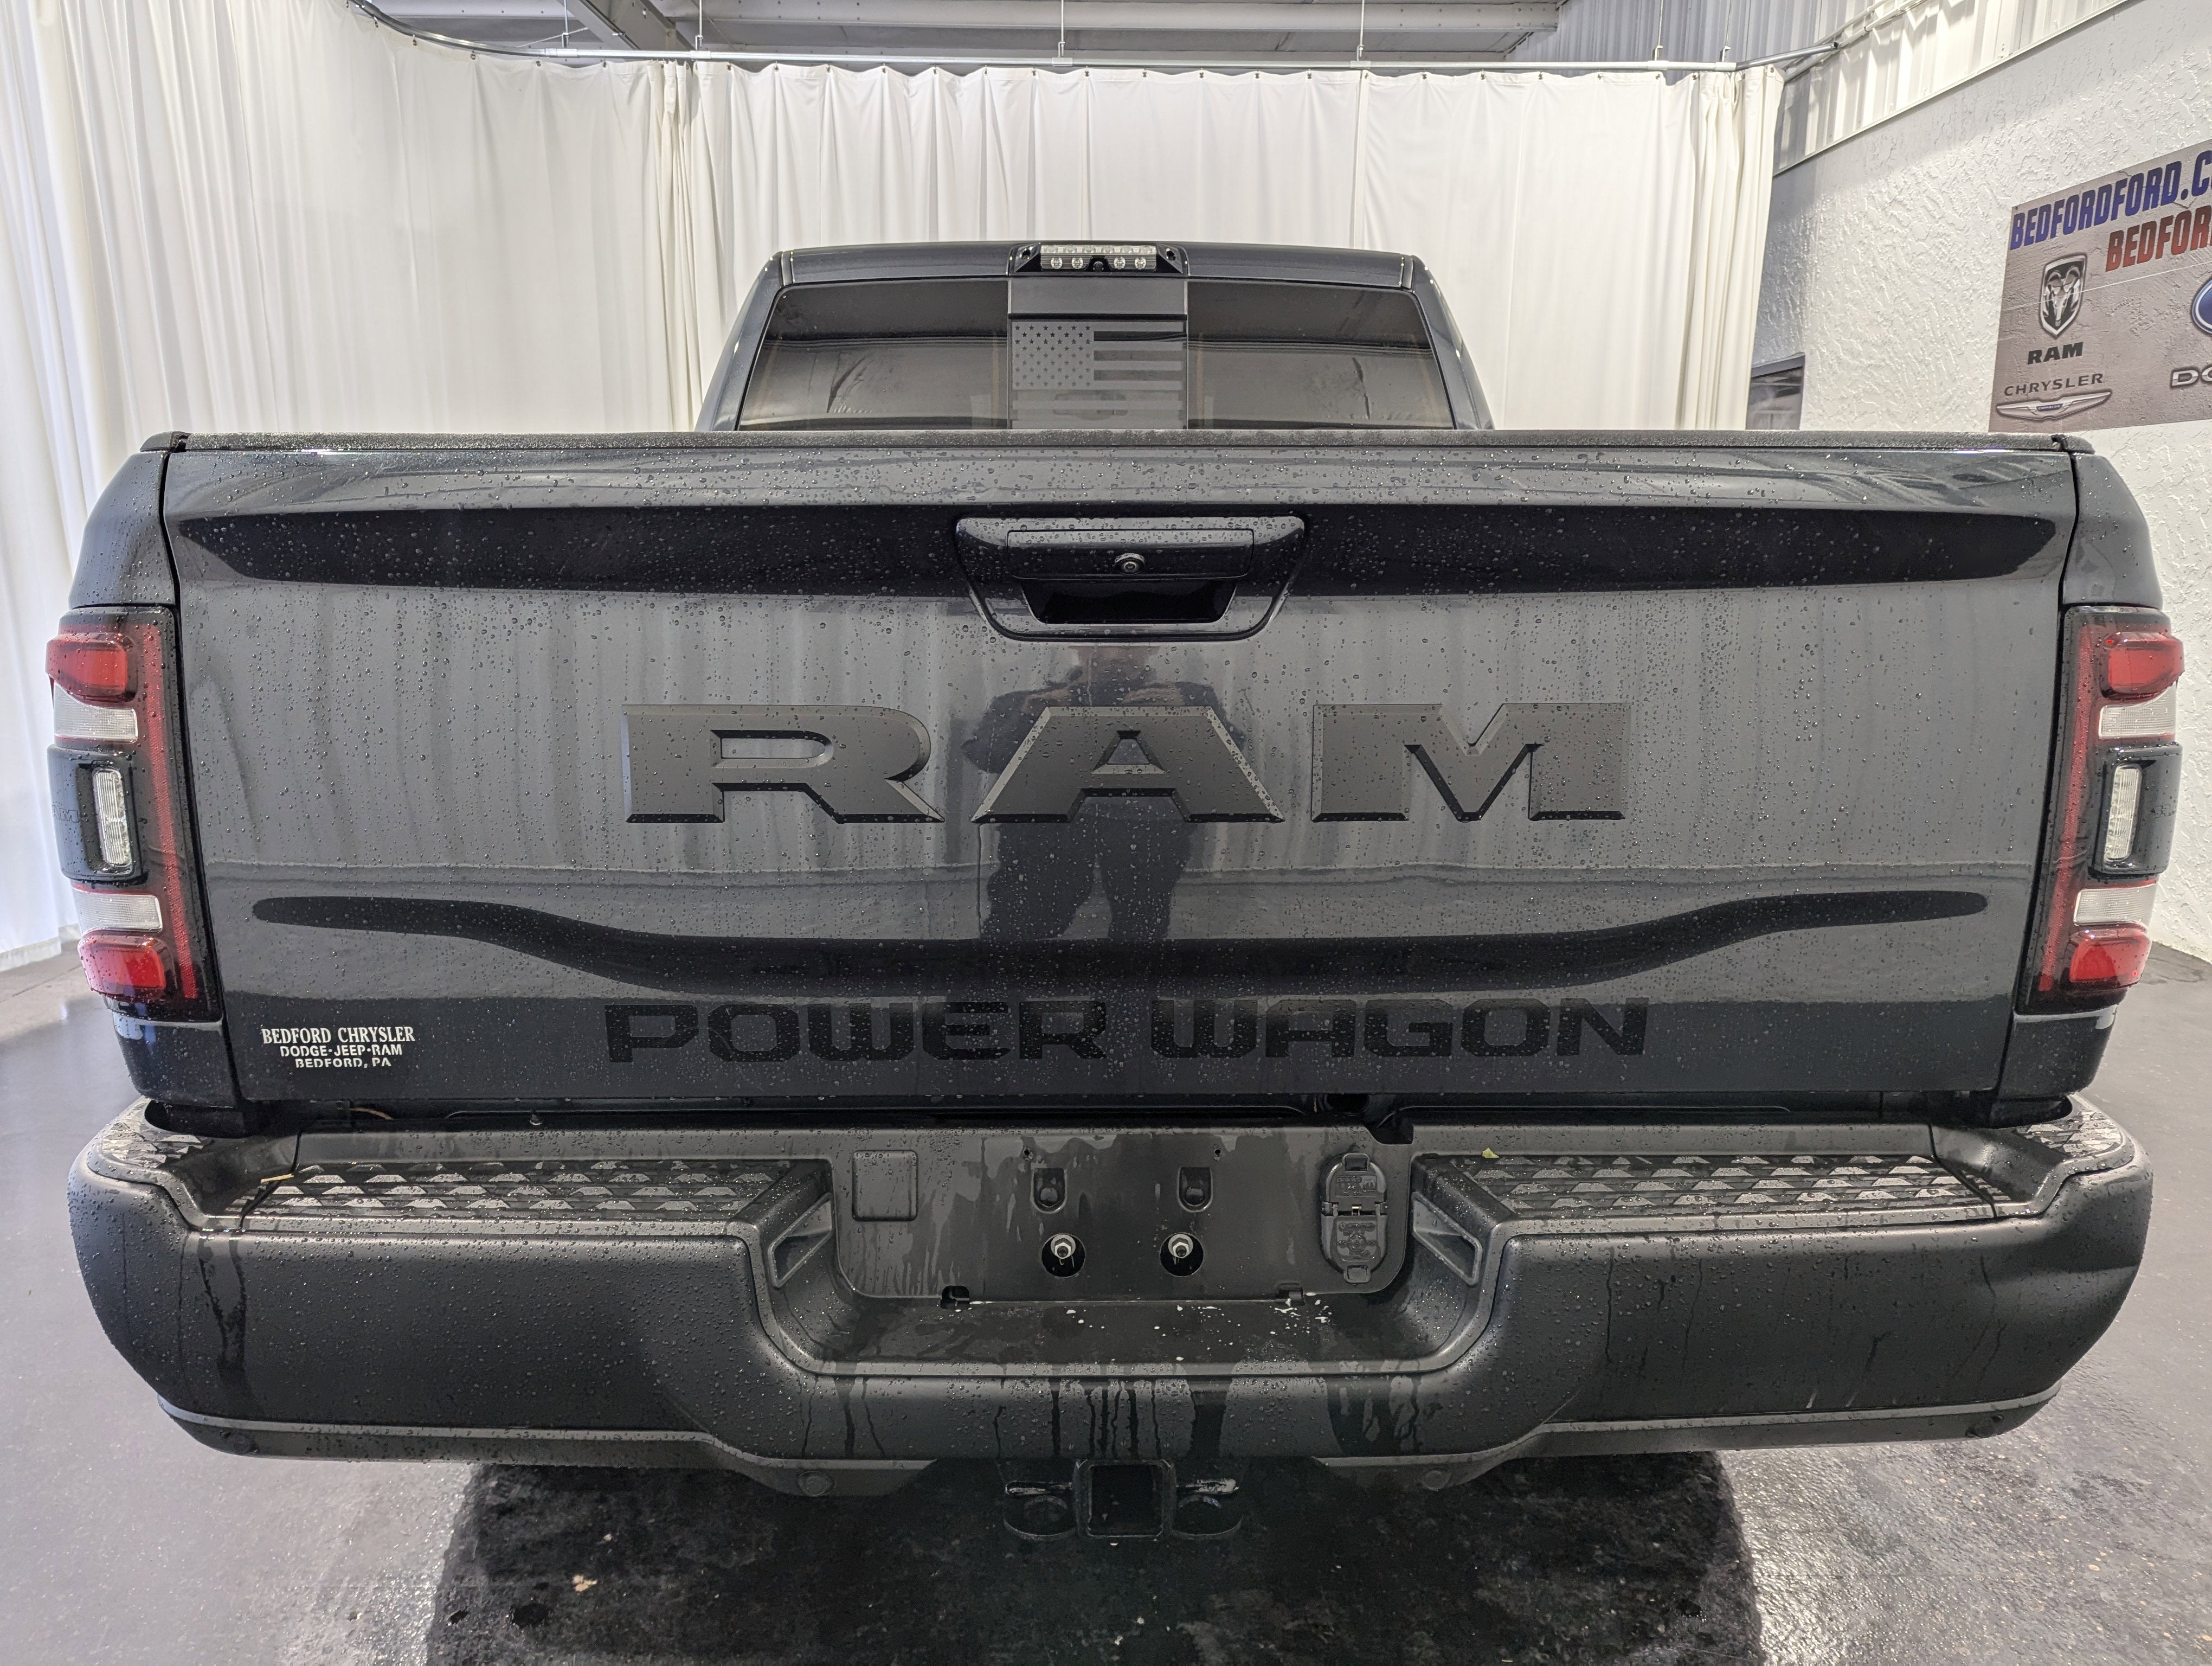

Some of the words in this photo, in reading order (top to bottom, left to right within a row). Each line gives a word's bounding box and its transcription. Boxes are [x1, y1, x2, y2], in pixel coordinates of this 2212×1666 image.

[2010, 150, 2212, 251] BEDFORDFORD.C
[2105, 205, 2212, 272] BEDFOR
[2027, 342, 2084, 365] RAM
[2004, 373, 2104, 396] CHRYSLER
[621, 703, 1629, 824] RAM
[262, 1028, 331, 1044] BEDFORD
[338, 1026, 416, 1043] CHRYSLER
[604, 1001, 1107, 1063] POWER
[1150, 997, 1649, 1058] WAGON
[295, 1058, 368, 1068] BEDFORD,
[372, 1058, 391, 1067] PA
